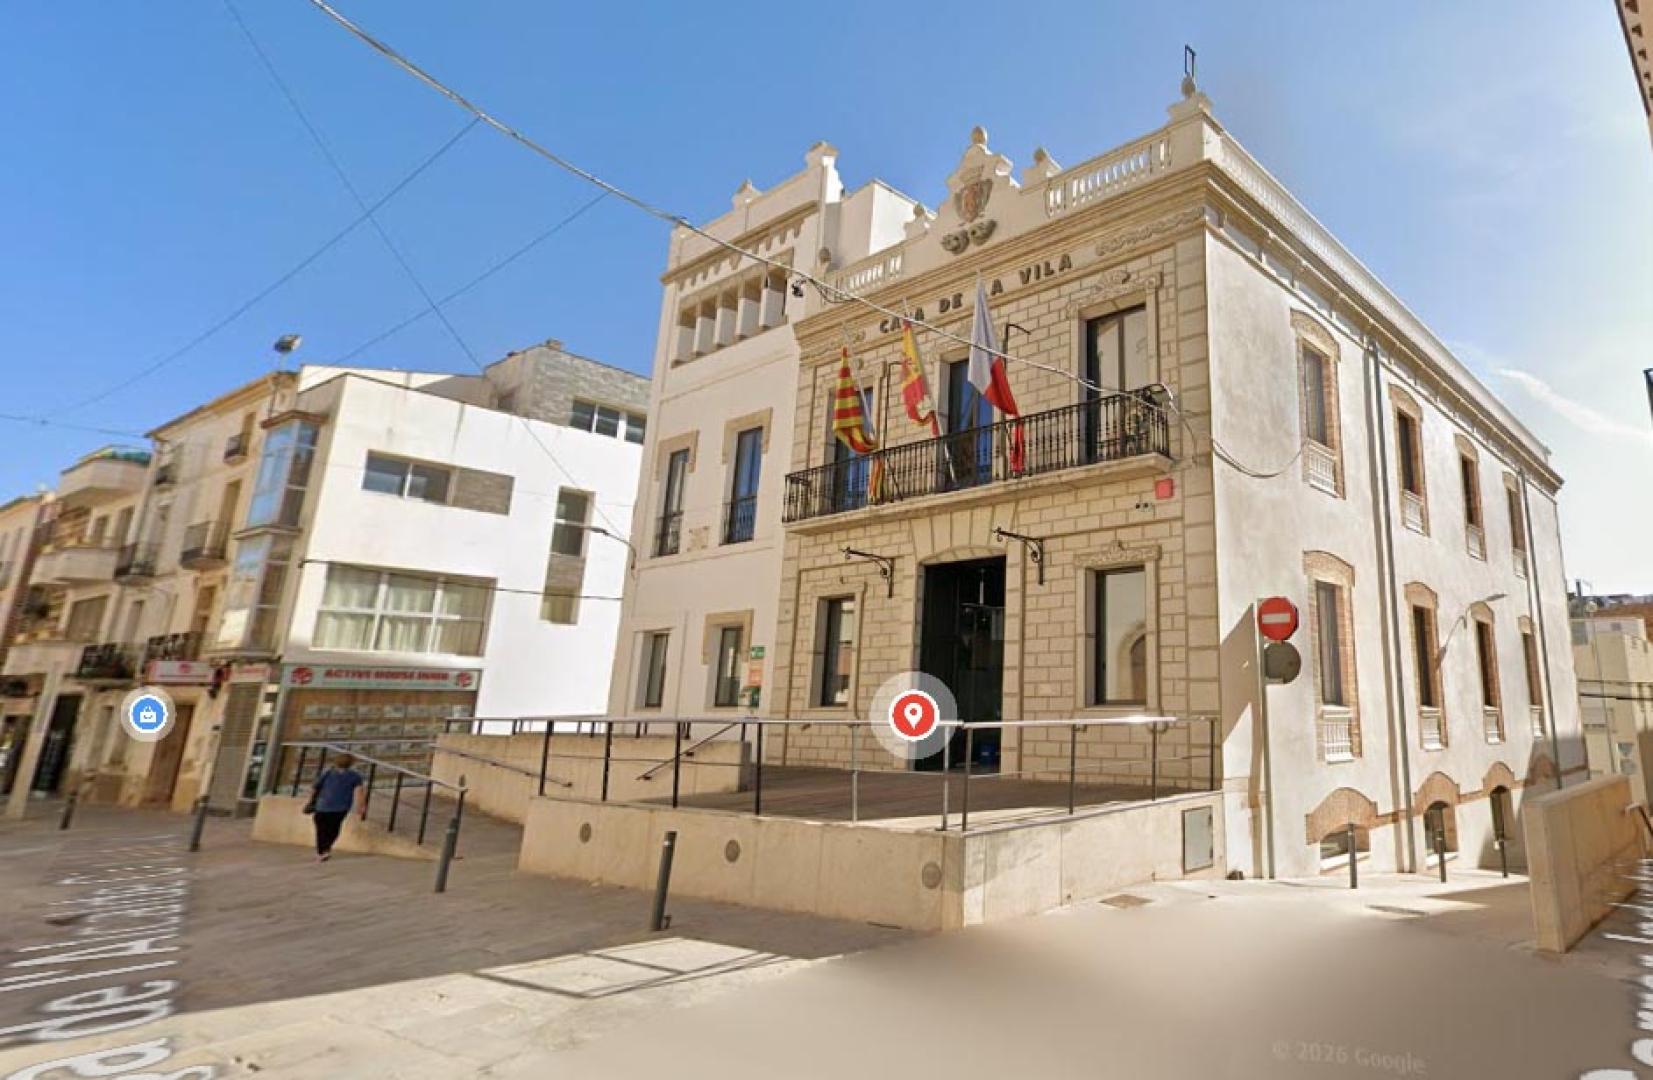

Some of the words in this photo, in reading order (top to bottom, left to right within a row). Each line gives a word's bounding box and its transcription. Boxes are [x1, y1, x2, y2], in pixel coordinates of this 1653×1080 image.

[879, 306, 925, 333] CAA
[939, 292, 963, 313] DE
[1019, 253, 1072, 284] VILA
